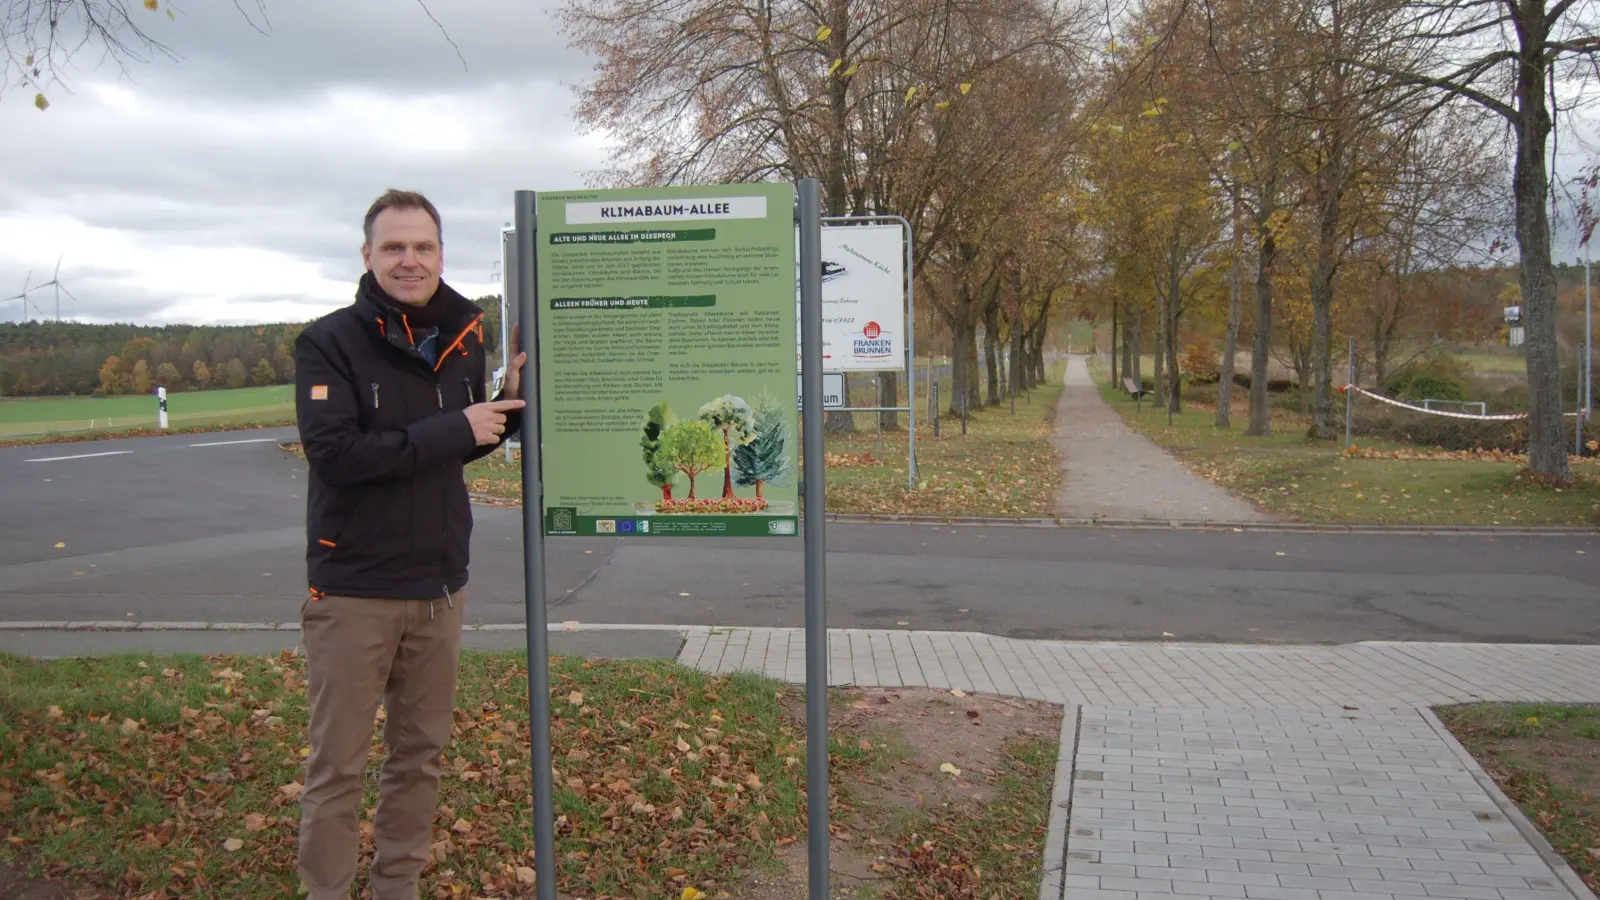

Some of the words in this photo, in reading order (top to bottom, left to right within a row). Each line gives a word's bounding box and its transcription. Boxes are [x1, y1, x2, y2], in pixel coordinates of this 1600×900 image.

[601, 203, 730, 218] KLIMABAUM-ALLEE
[874, 261, 891, 274] Küche
[581, 298, 608, 307] FRÜHER
